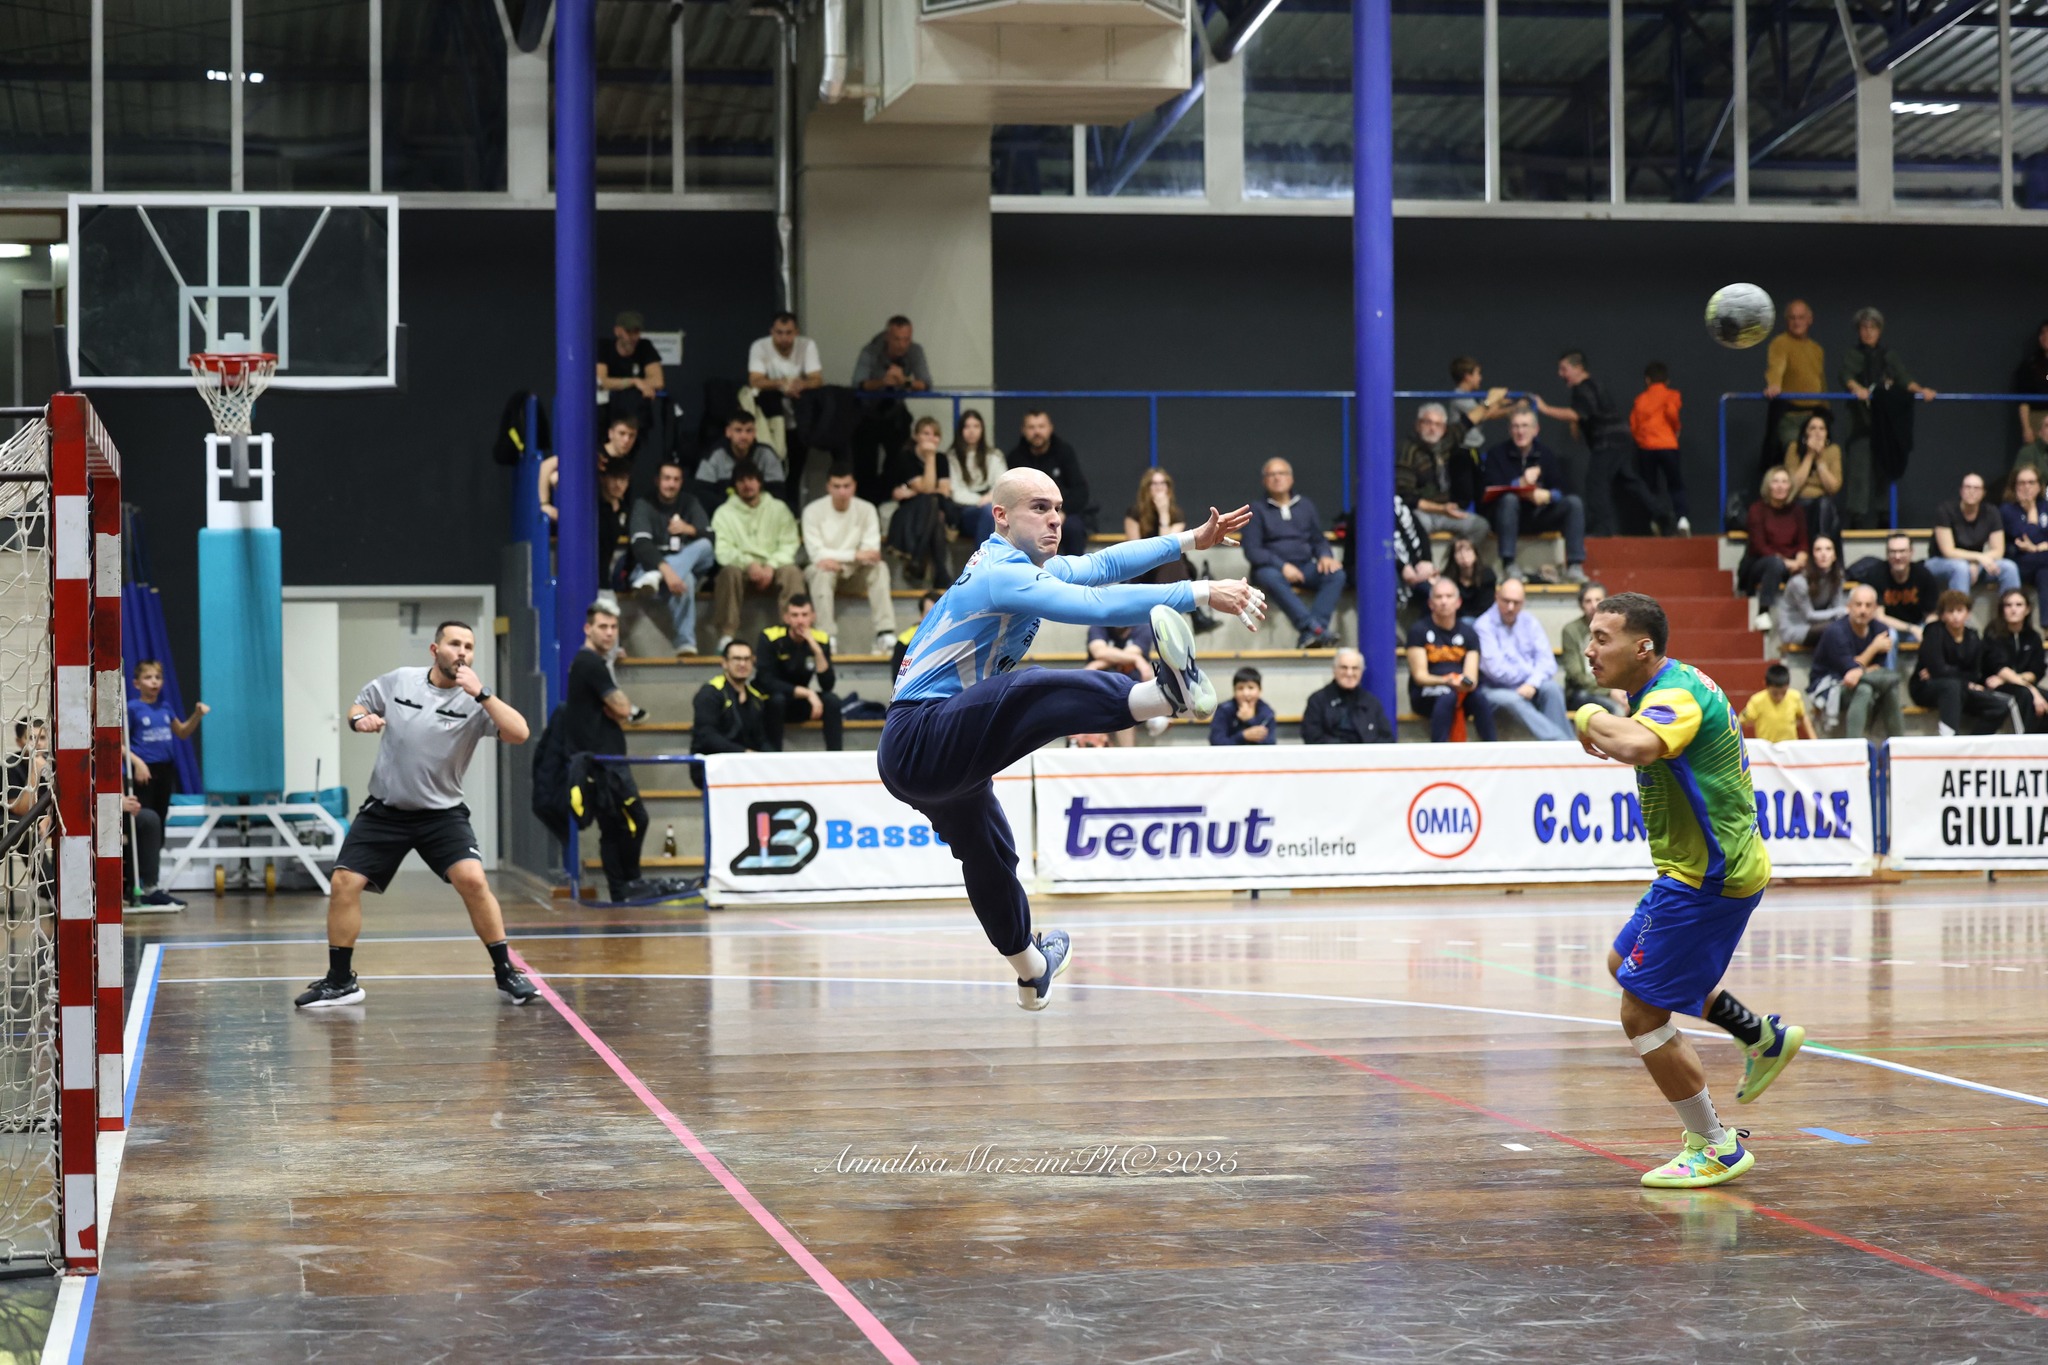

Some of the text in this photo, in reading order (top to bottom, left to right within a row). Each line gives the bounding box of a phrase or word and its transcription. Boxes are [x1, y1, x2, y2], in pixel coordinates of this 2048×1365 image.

[1941, 769, 2048, 798] AFFILAT
[1064, 797, 1356, 860] tecnut ensileria
[1416, 807, 1473, 834] OMIA
[1534, 793, 1602, 844] G.C.
